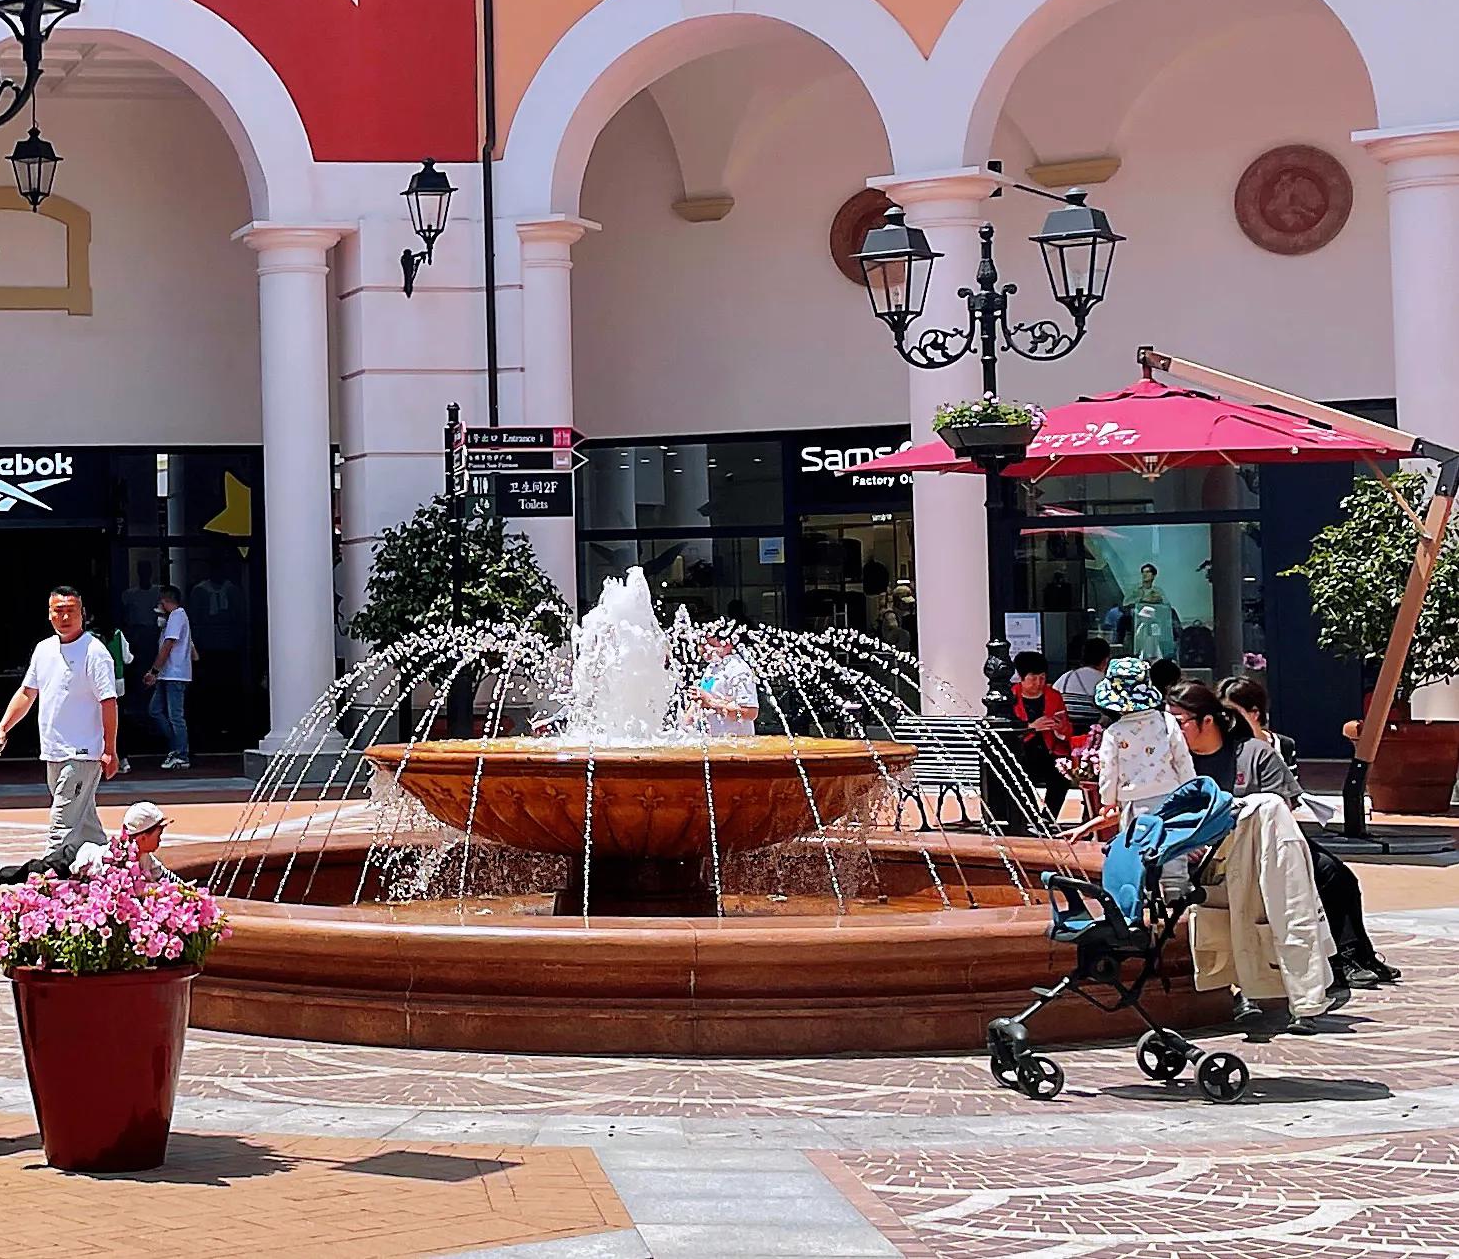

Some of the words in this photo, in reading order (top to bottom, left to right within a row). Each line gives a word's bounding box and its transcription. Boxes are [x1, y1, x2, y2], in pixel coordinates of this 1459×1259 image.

[801, 440, 913, 472] Sams
[852, 475, 895, 487] Factory
[517, 498, 549, 510] Toilets
